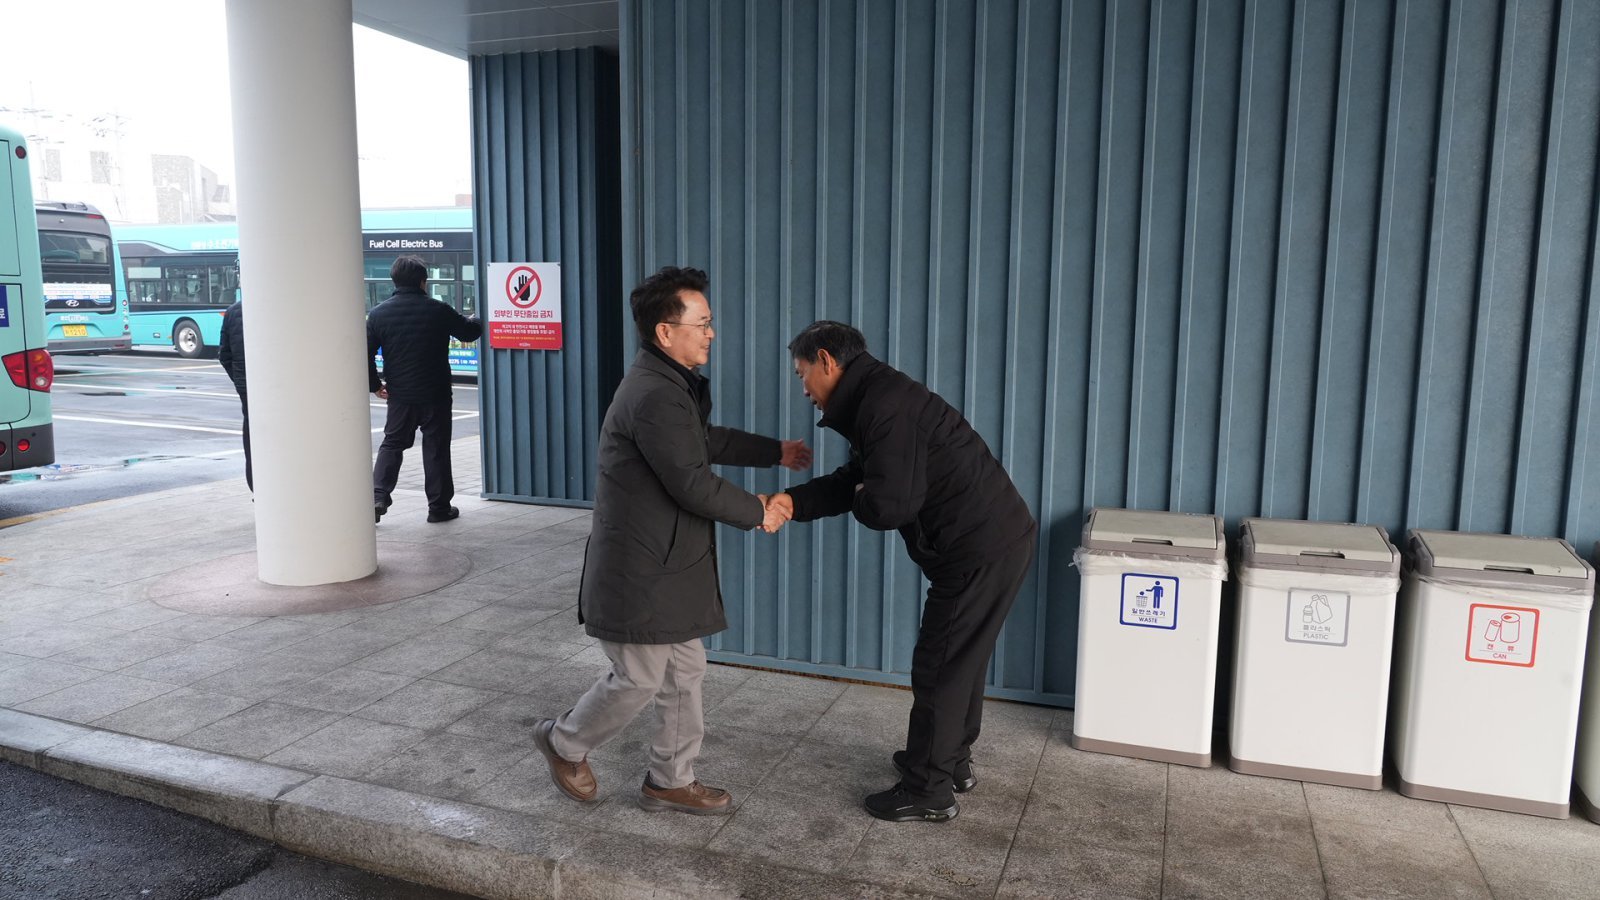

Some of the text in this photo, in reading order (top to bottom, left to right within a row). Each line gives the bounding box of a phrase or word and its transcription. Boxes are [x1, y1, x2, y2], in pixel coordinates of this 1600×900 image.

[369, 240, 443, 248] Fuel Cell Electric Bus
[494, 310, 553, 318] 외부인 무단출입 금지
[1132, 608, 1166, 616] 일반쓰레기
